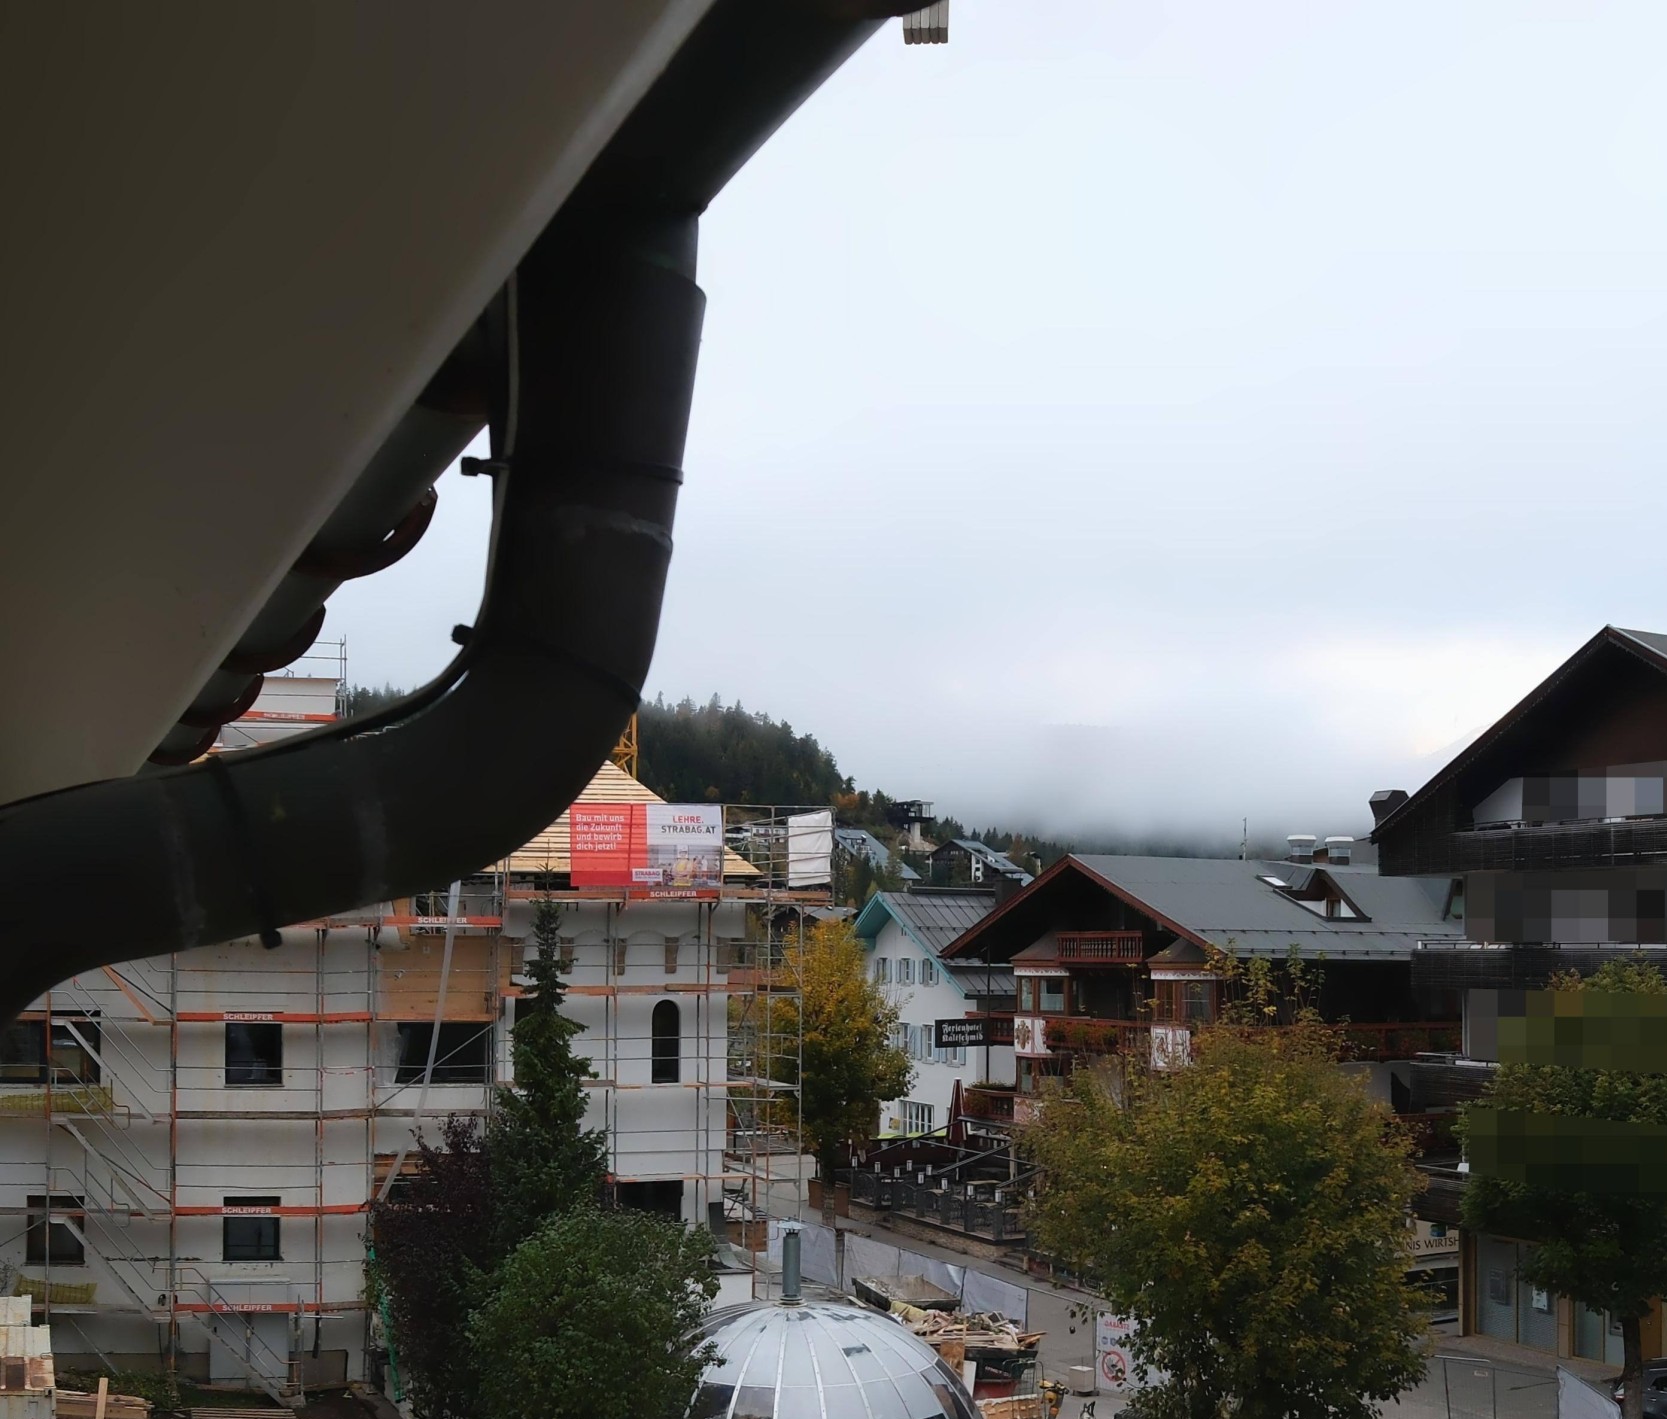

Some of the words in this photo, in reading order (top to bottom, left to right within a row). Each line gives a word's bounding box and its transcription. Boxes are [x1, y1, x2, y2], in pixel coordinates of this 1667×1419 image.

[576, 814, 592, 822] Bau
[594, 813, 606, 822] mit
[608, 814, 624, 822] uns
[672, 815, 704, 824] LEHRE.
[576, 823, 588, 832] die
[590, 823, 622, 832] Zukunft
[661, 825, 716, 835] STRABAG.AT
[576, 832, 591, 841] und
[593, 832, 622, 841] bewirb
[576, 842, 593, 851] dich
[594, 842, 617, 852] jetzt!
[650, 890, 697, 898] SCHLEIPFER
[223, 1013, 273, 1021] SCHLEIPFER
[222, 1206, 272, 1215] SCHLEIPFER
